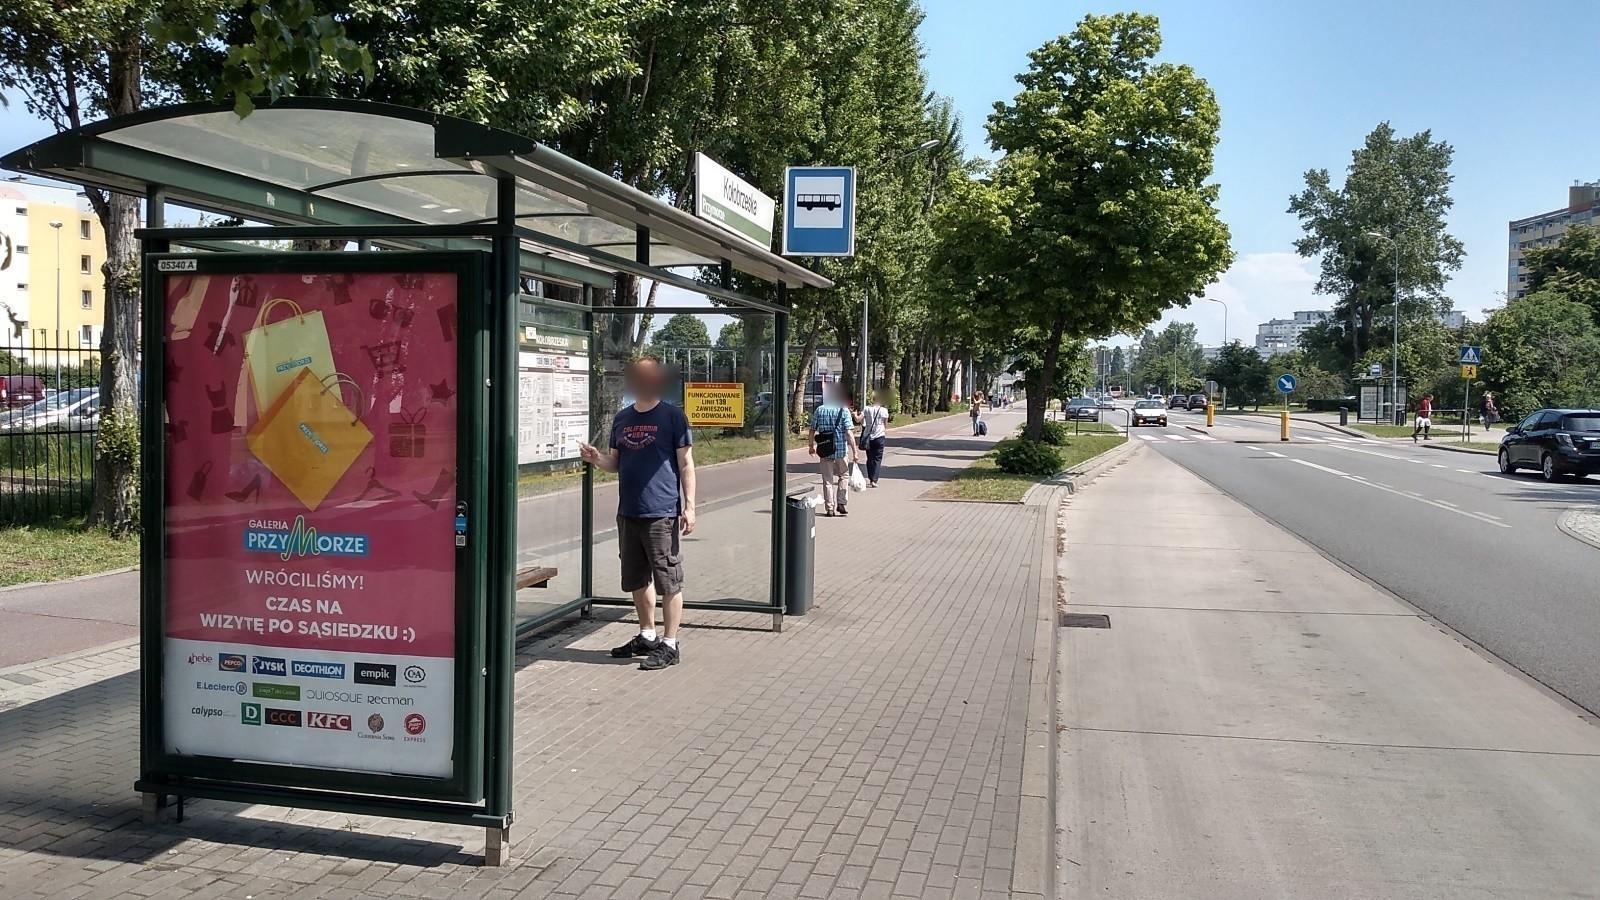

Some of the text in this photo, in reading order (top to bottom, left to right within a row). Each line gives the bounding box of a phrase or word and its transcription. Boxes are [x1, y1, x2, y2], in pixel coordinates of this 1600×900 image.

[161, 261, 194, 269] 05340 A
[248, 519, 289, 530] GALERIA
[248, 515, 364, 561] PRZYMORZE
[246, 568, 364, 590] WRÓCILIŚMY!
[265, 597, 343, 615] CZAS NA
[200, 613, 416, 644] WIZYTĘ PO SĄSIEDZKU :)
[191, 653, 213, 663] hebe
[259, 660, 285, 672] JYSK
[294, 663, 342, 675] DECATHLON
[360, 667, 390, 680] empik
[196, 682, 235, 692] E.Leclerc
[306, 689, 362, 703] QUIOSQUE
[191, 705, 223, 718] calypso
[245, 706, 258, 719] D
[270, 711, 297, 724] CCC
[309, 713, 349, 730] KFC
